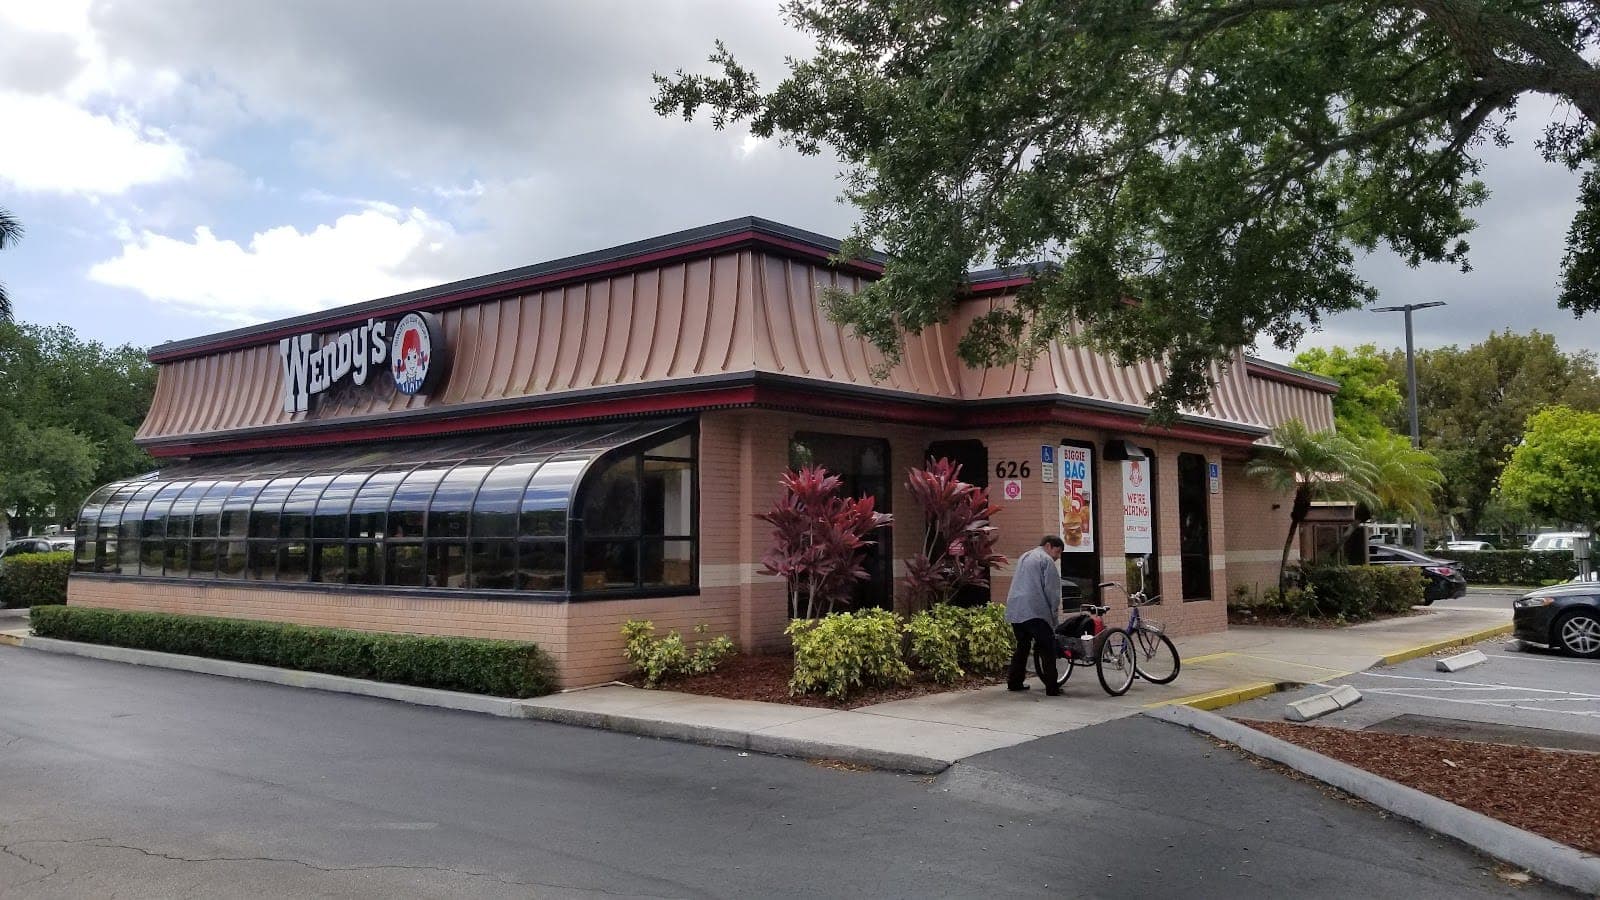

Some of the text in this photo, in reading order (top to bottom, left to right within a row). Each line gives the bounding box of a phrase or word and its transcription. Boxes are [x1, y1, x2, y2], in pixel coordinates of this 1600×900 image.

[280, 318, 387, 412] Wendy's
[1064, 449, 1086, 461] BIGGIE
[996, 460, 1030, 479] 626
[1064, 460, 1086, 480] BAG
[1064, 478, 1086, 512] $5
[1127, 492, 1146, 505] WE'RE
